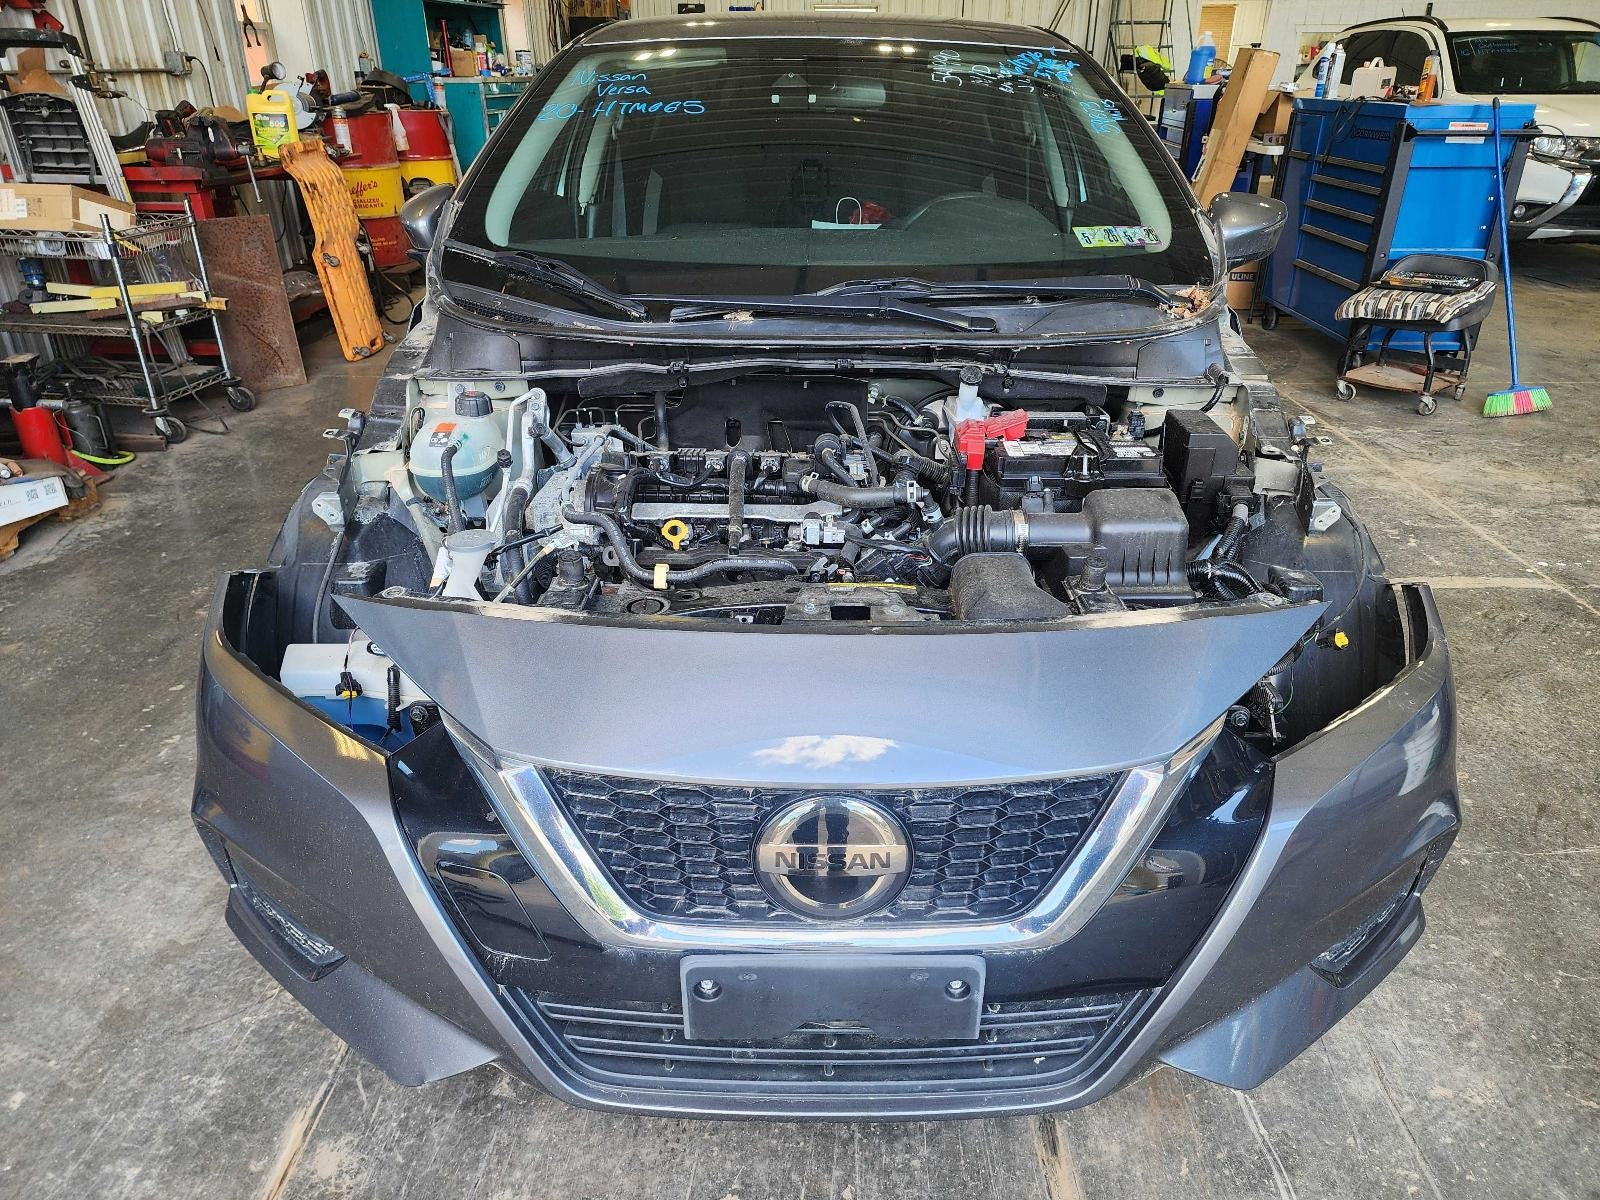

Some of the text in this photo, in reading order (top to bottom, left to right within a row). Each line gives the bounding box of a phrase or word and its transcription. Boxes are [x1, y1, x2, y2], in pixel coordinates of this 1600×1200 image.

[571, 69, 647, 86] Nissan
[597, 83, 651, 97] Versa
[350, 180, 378, 198] effer's
[1231, 273, 1254, 281] ULINE
[775, 852, 891, 870] NISSAN
